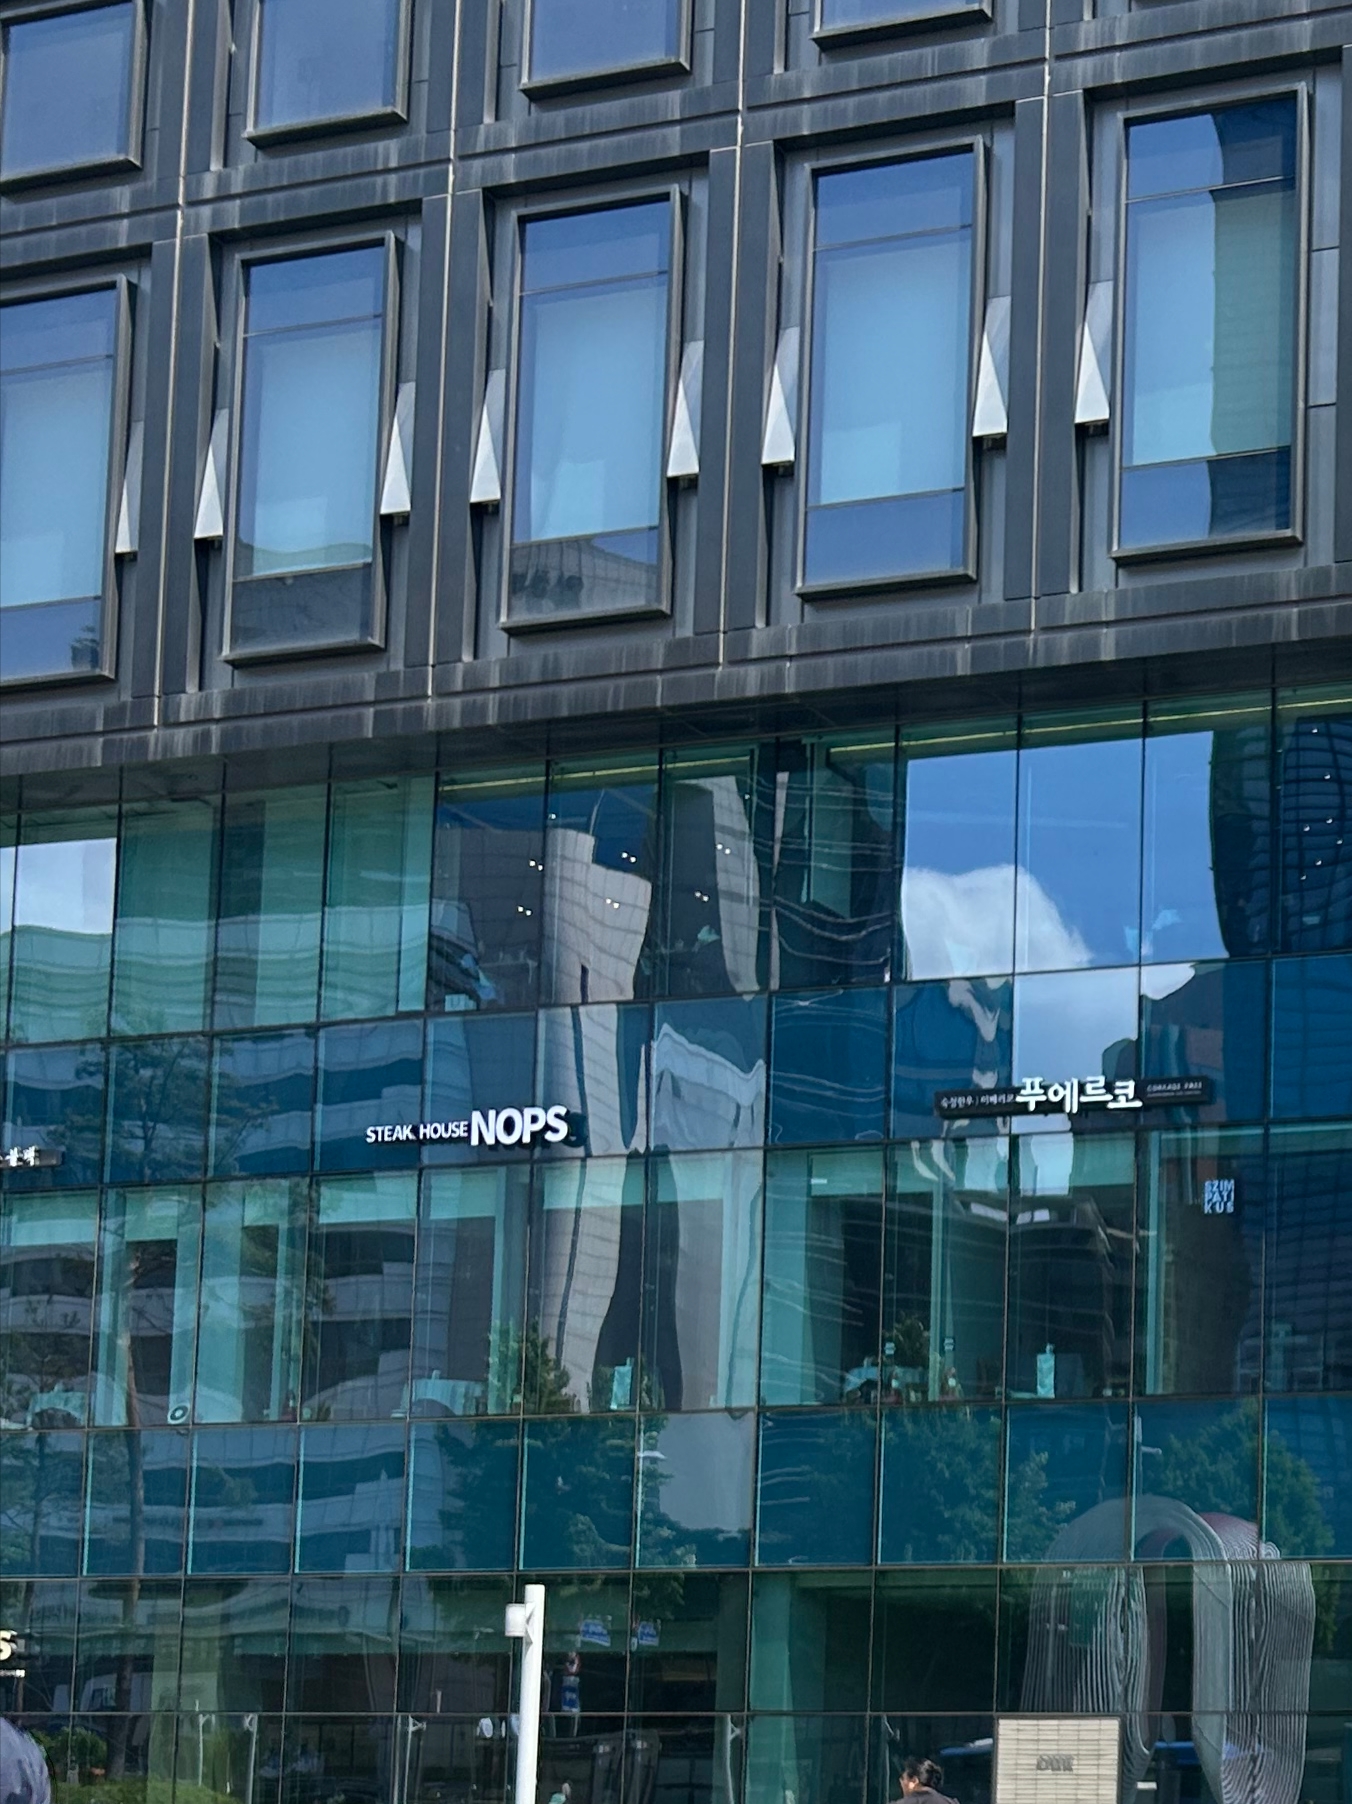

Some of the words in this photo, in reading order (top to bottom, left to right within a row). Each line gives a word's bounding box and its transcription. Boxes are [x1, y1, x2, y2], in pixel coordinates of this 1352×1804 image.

[1016, 1075, 1142, 1113] 푸에르코
[366, 1123, 415, 1143] STEAK
[419, 1120, 468, 1140] HOUSE
[471, 1105, 568, 1146] NOPS
